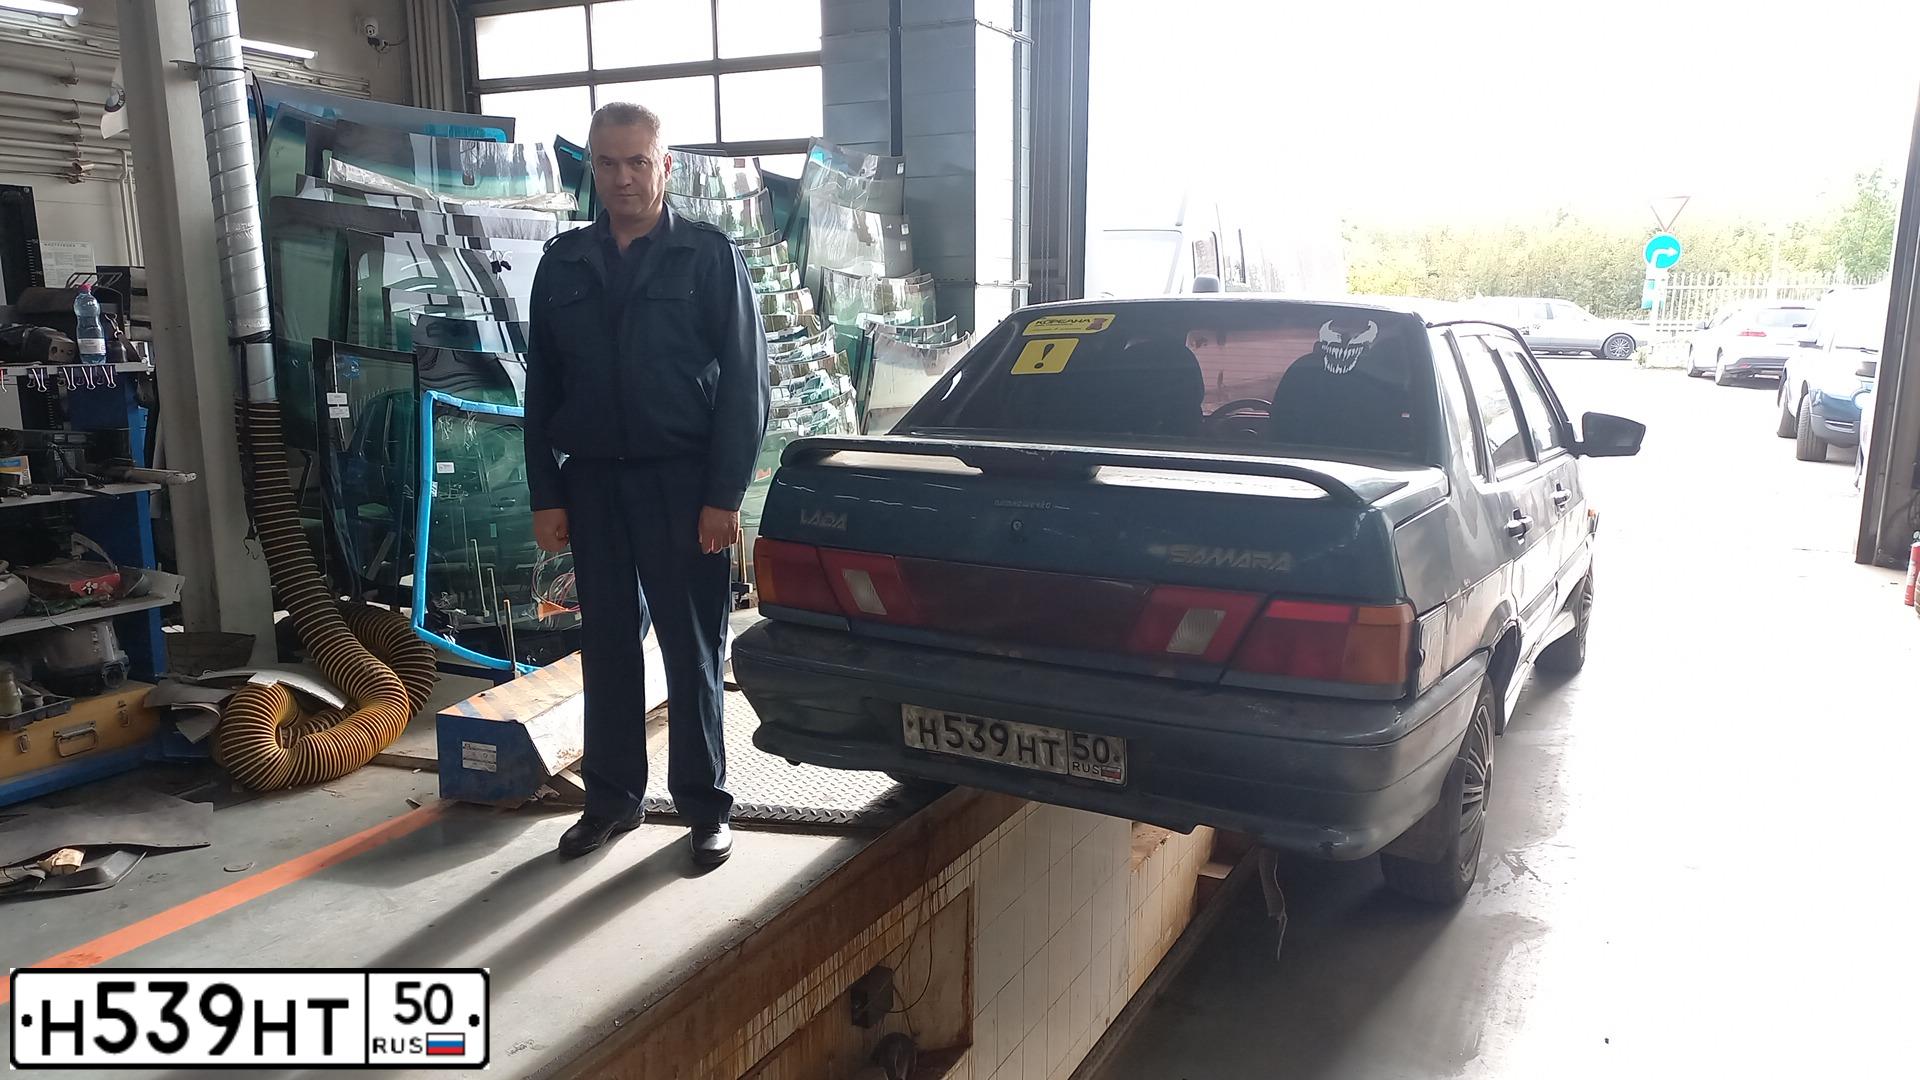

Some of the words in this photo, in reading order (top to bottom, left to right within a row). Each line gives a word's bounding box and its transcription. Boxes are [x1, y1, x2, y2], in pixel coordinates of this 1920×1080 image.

[1167, 543, 1292, 572] SAMARA
[918, 714, 1060, 767] Н539НТ
[1072, 733, 1110, 764] 50
[1072, 761, 1100, 775] RUS
